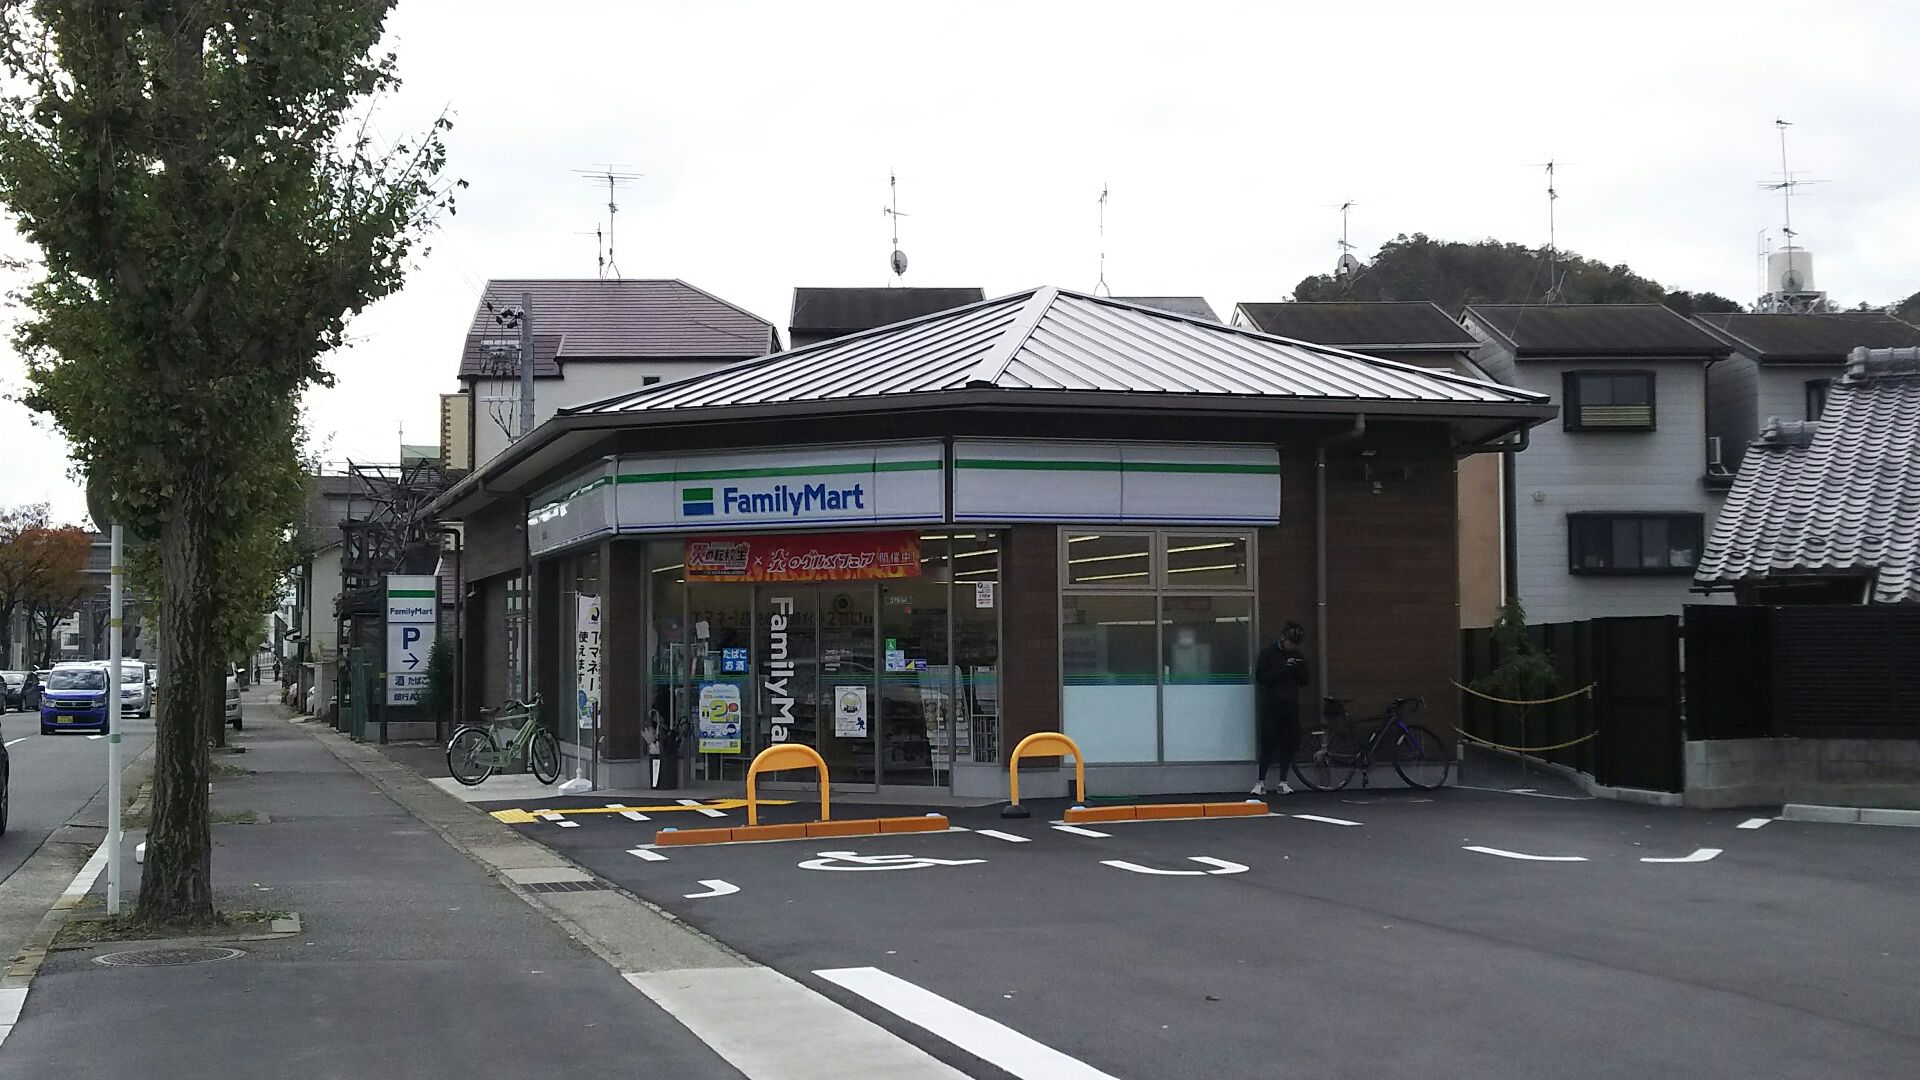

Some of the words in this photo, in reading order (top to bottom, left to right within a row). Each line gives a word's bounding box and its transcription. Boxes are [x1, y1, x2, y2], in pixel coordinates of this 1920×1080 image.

[723, 483, 864, 516] FamilyMart
[390, 607, 433, 616] FamilyMart
[403, 627, 421, 650] P
[722, 648, 747, 659] たばこ
[725, 660, 745, 671] お酒
[764, 596, 795, 747] FamilyMa
[395, 675, 405, 686] 酒
